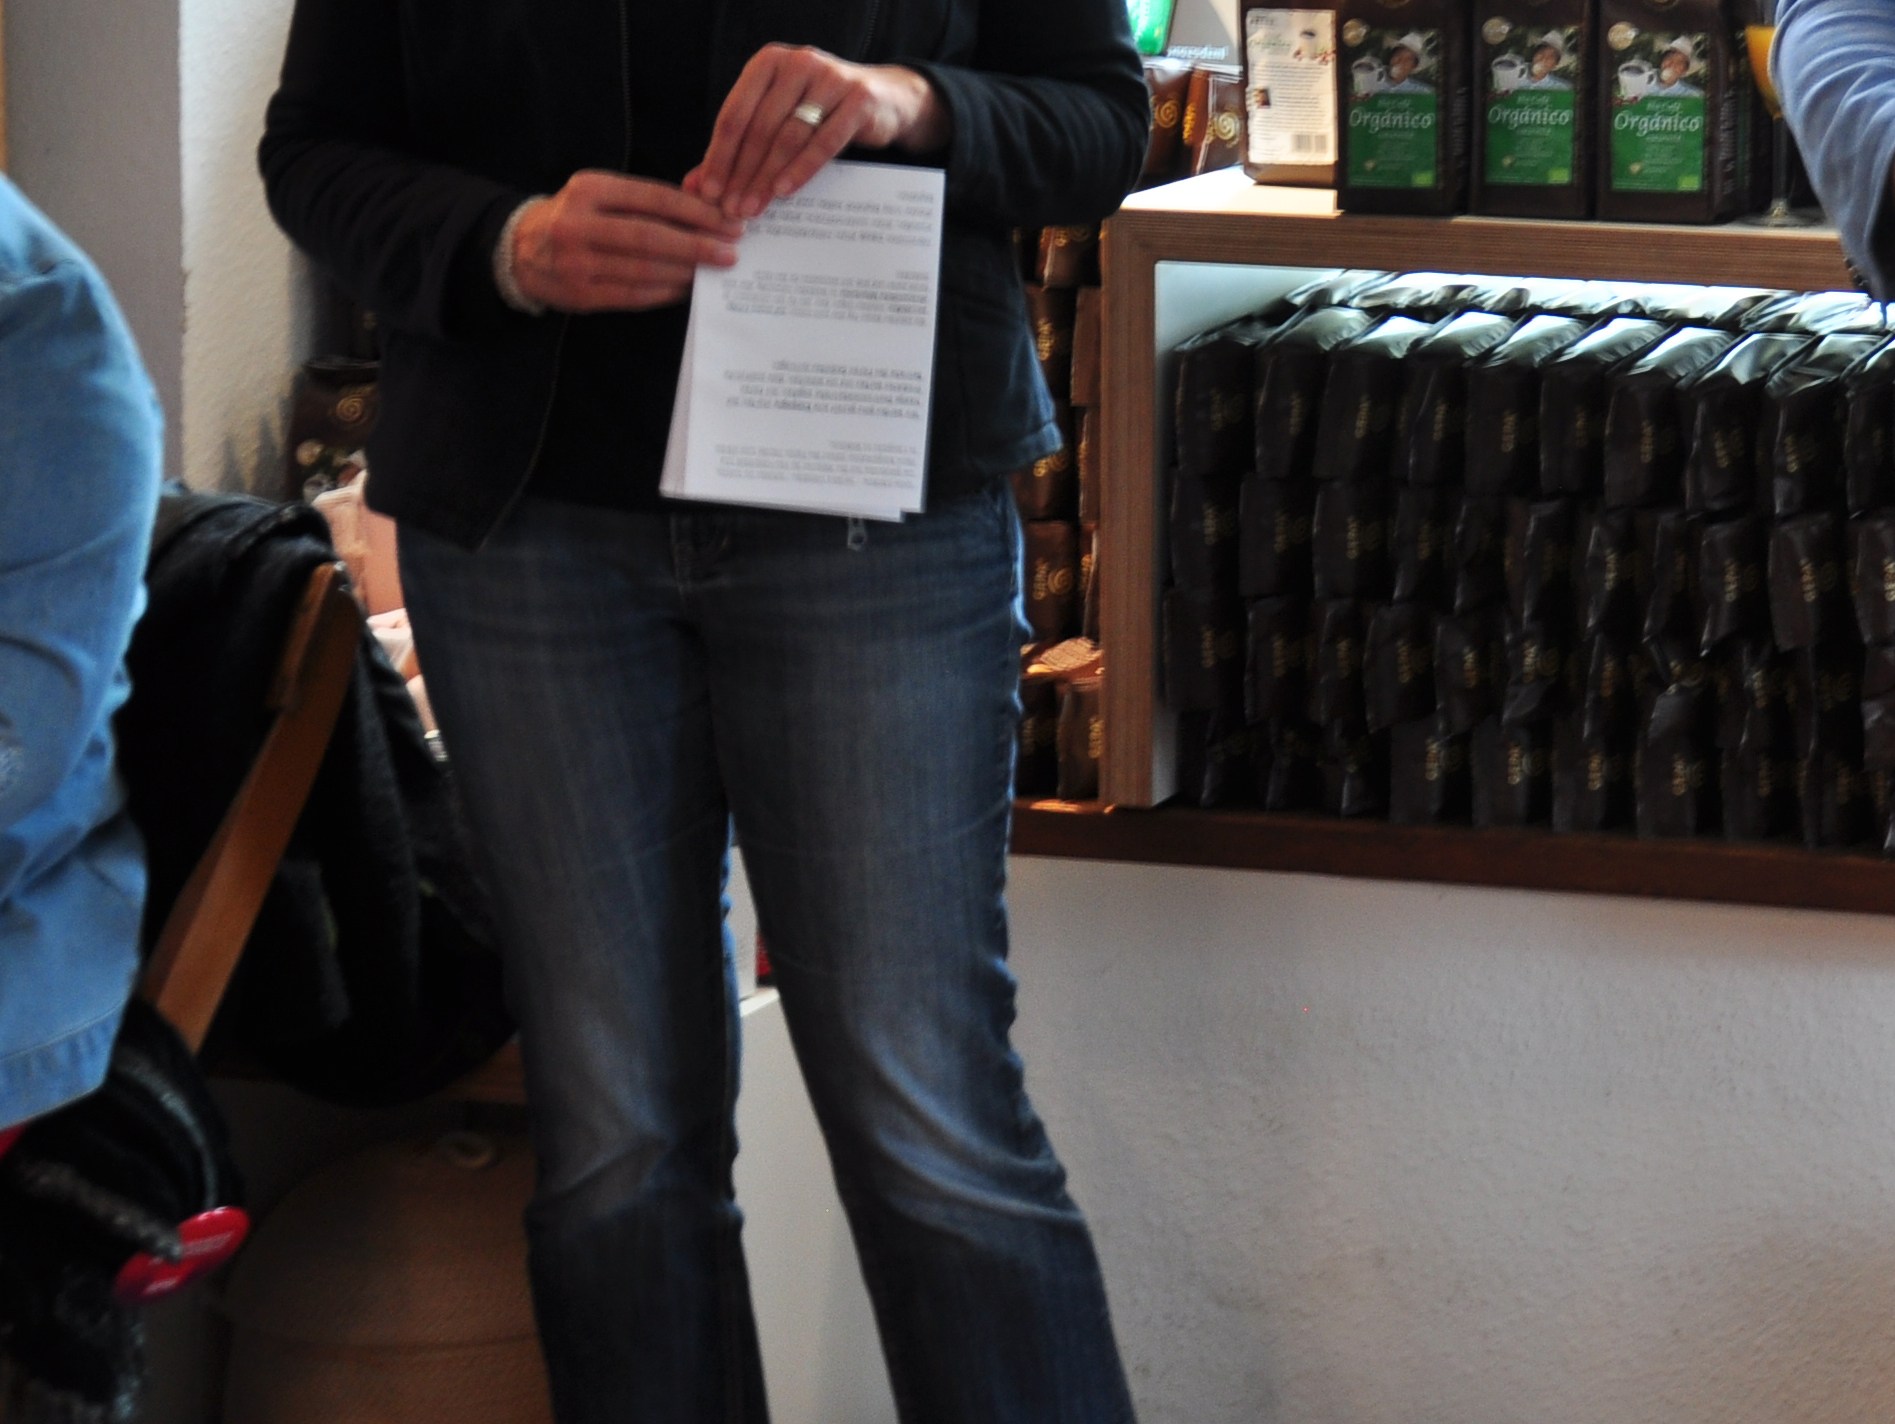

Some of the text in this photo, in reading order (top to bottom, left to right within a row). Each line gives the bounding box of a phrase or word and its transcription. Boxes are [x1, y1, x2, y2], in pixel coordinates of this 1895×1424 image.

[1350, 107, 1436, 135] Orgánico
[1488, 105, 1574, 131] Orgánico
[1614, 108, 1703, 137] Orgánico
